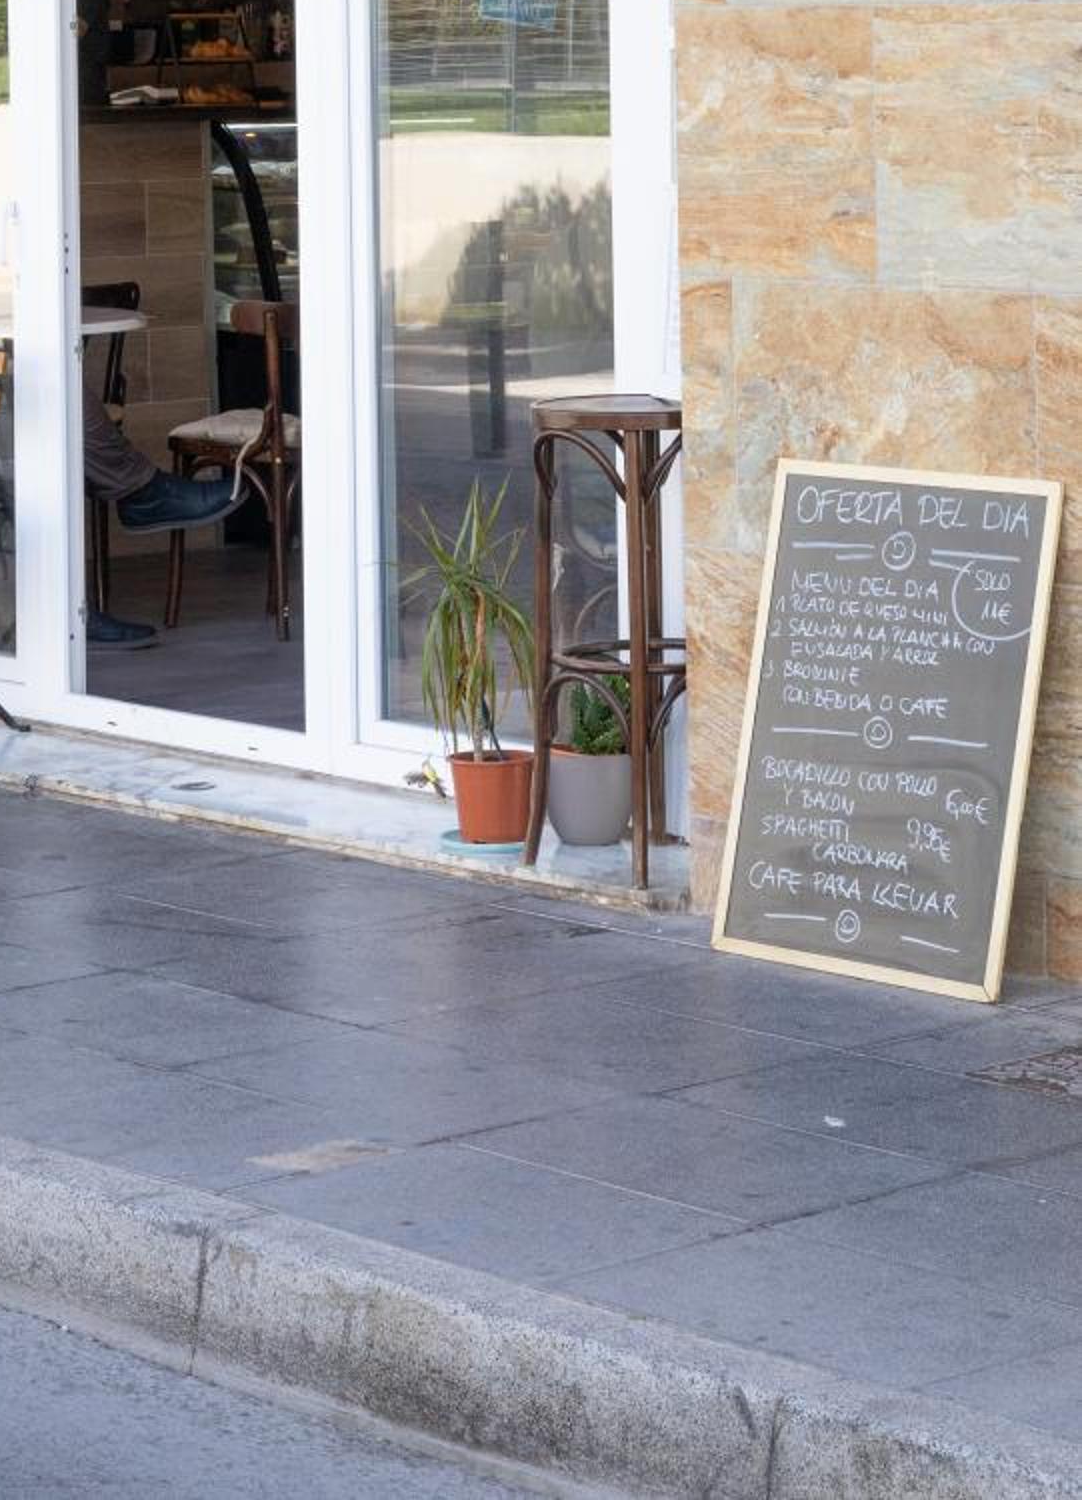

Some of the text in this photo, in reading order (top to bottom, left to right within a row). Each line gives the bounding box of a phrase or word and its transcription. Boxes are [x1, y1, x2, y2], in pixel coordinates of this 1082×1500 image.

[797, 485, 1029, 539] OFERTA DEL DIA
[791, 570, 852, 595] MENU
[859, 575, 897, 597] DEL
[974, 569, 1012, 591] SOLO
[790, 593, 834, 613] PLATO
[839, 600, 861, 618] DE
[864, 601, 907, 621] QUESO
[853, 622, 864, 639] A
[868, 624, 886, 643] LA
[892, 625, 963, 651] PLANCHA
[965, 636, 997, 656] CON
[880, 695, 892, 711] O
[900, 697, 948, 718] CAFE
[762, 756, 938, 797] BOCADILLO CON POLLO
[784, 784, 855, 815] Y BACON
[761, 815, 849, 842] SPAGHETTI
[813, 842, 908, 874] CARBONARA
[749, 861, 959, 918] CAFE PARA LLEVAR
